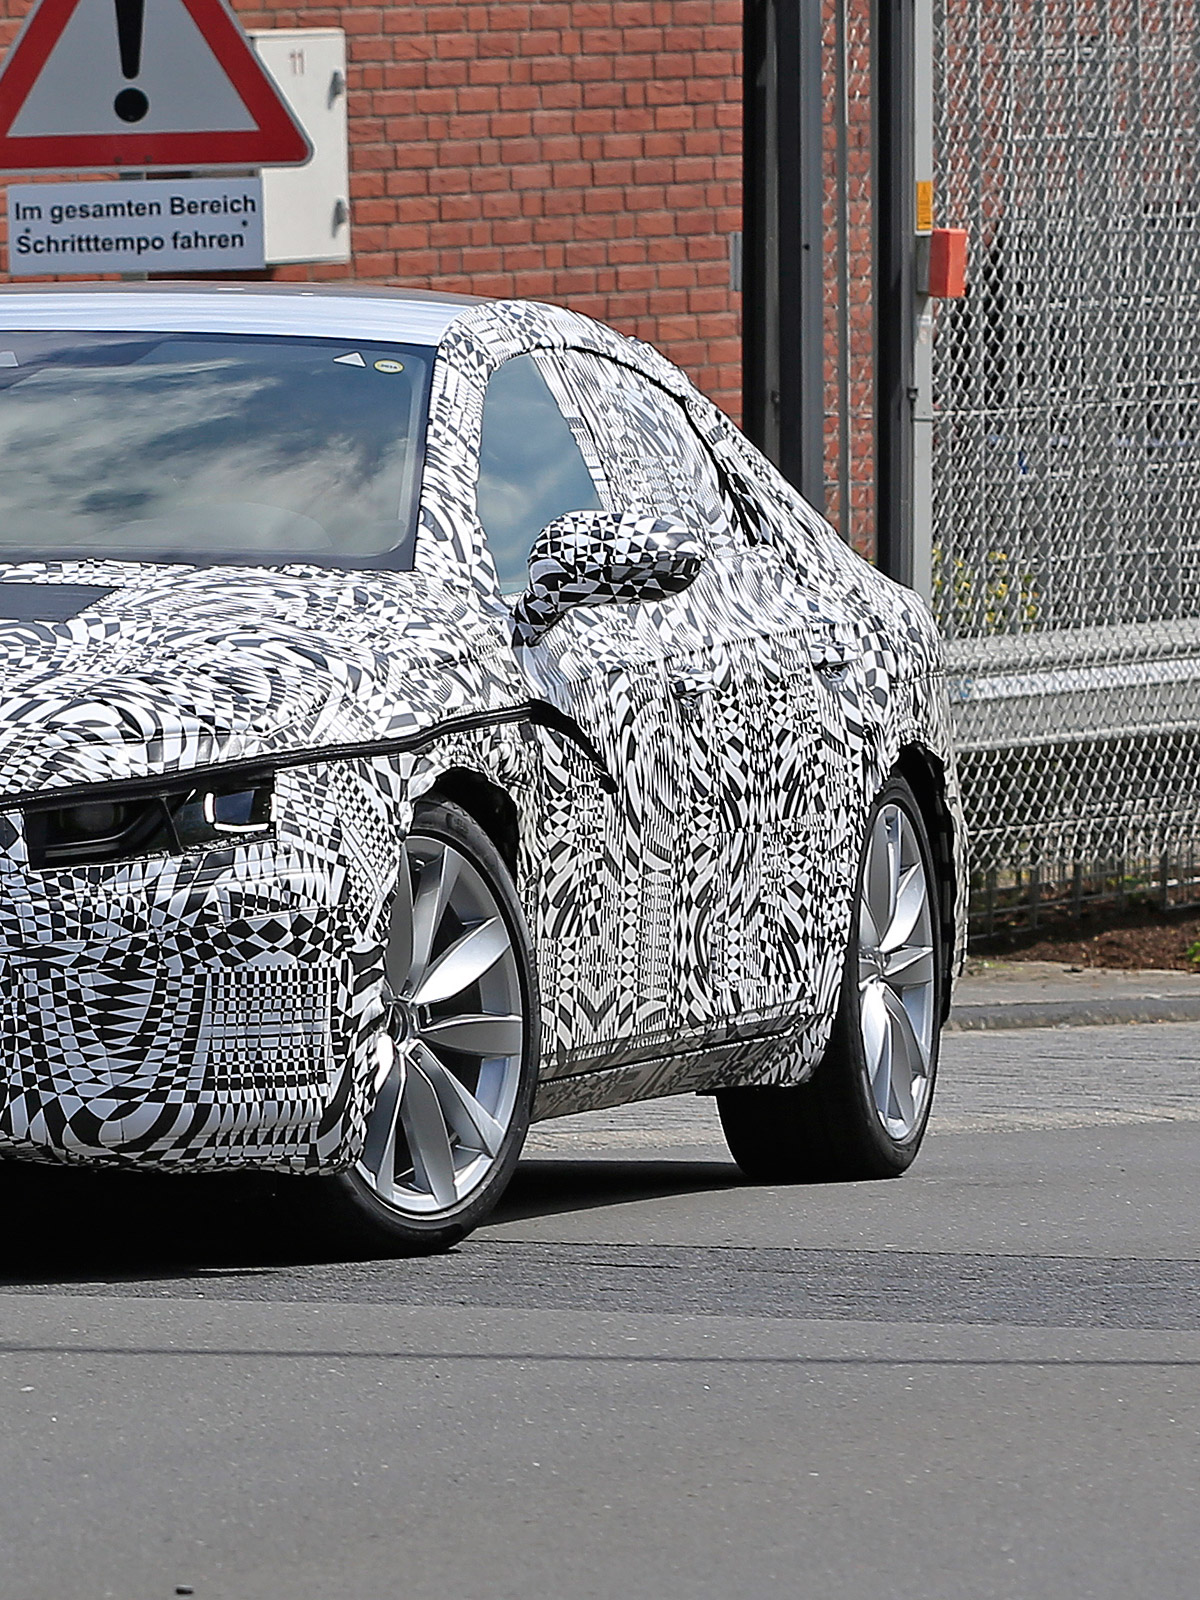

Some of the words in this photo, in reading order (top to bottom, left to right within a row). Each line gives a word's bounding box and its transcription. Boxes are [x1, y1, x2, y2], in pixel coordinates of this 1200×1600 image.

[15, 202, 42, 220] Im
[50, 200, 161, 224] gesamten
[170, 195, 256, 215] Bereich
[16, 234, 164, 254] Schritttempo
[172, 231, 244, 249] fahren
